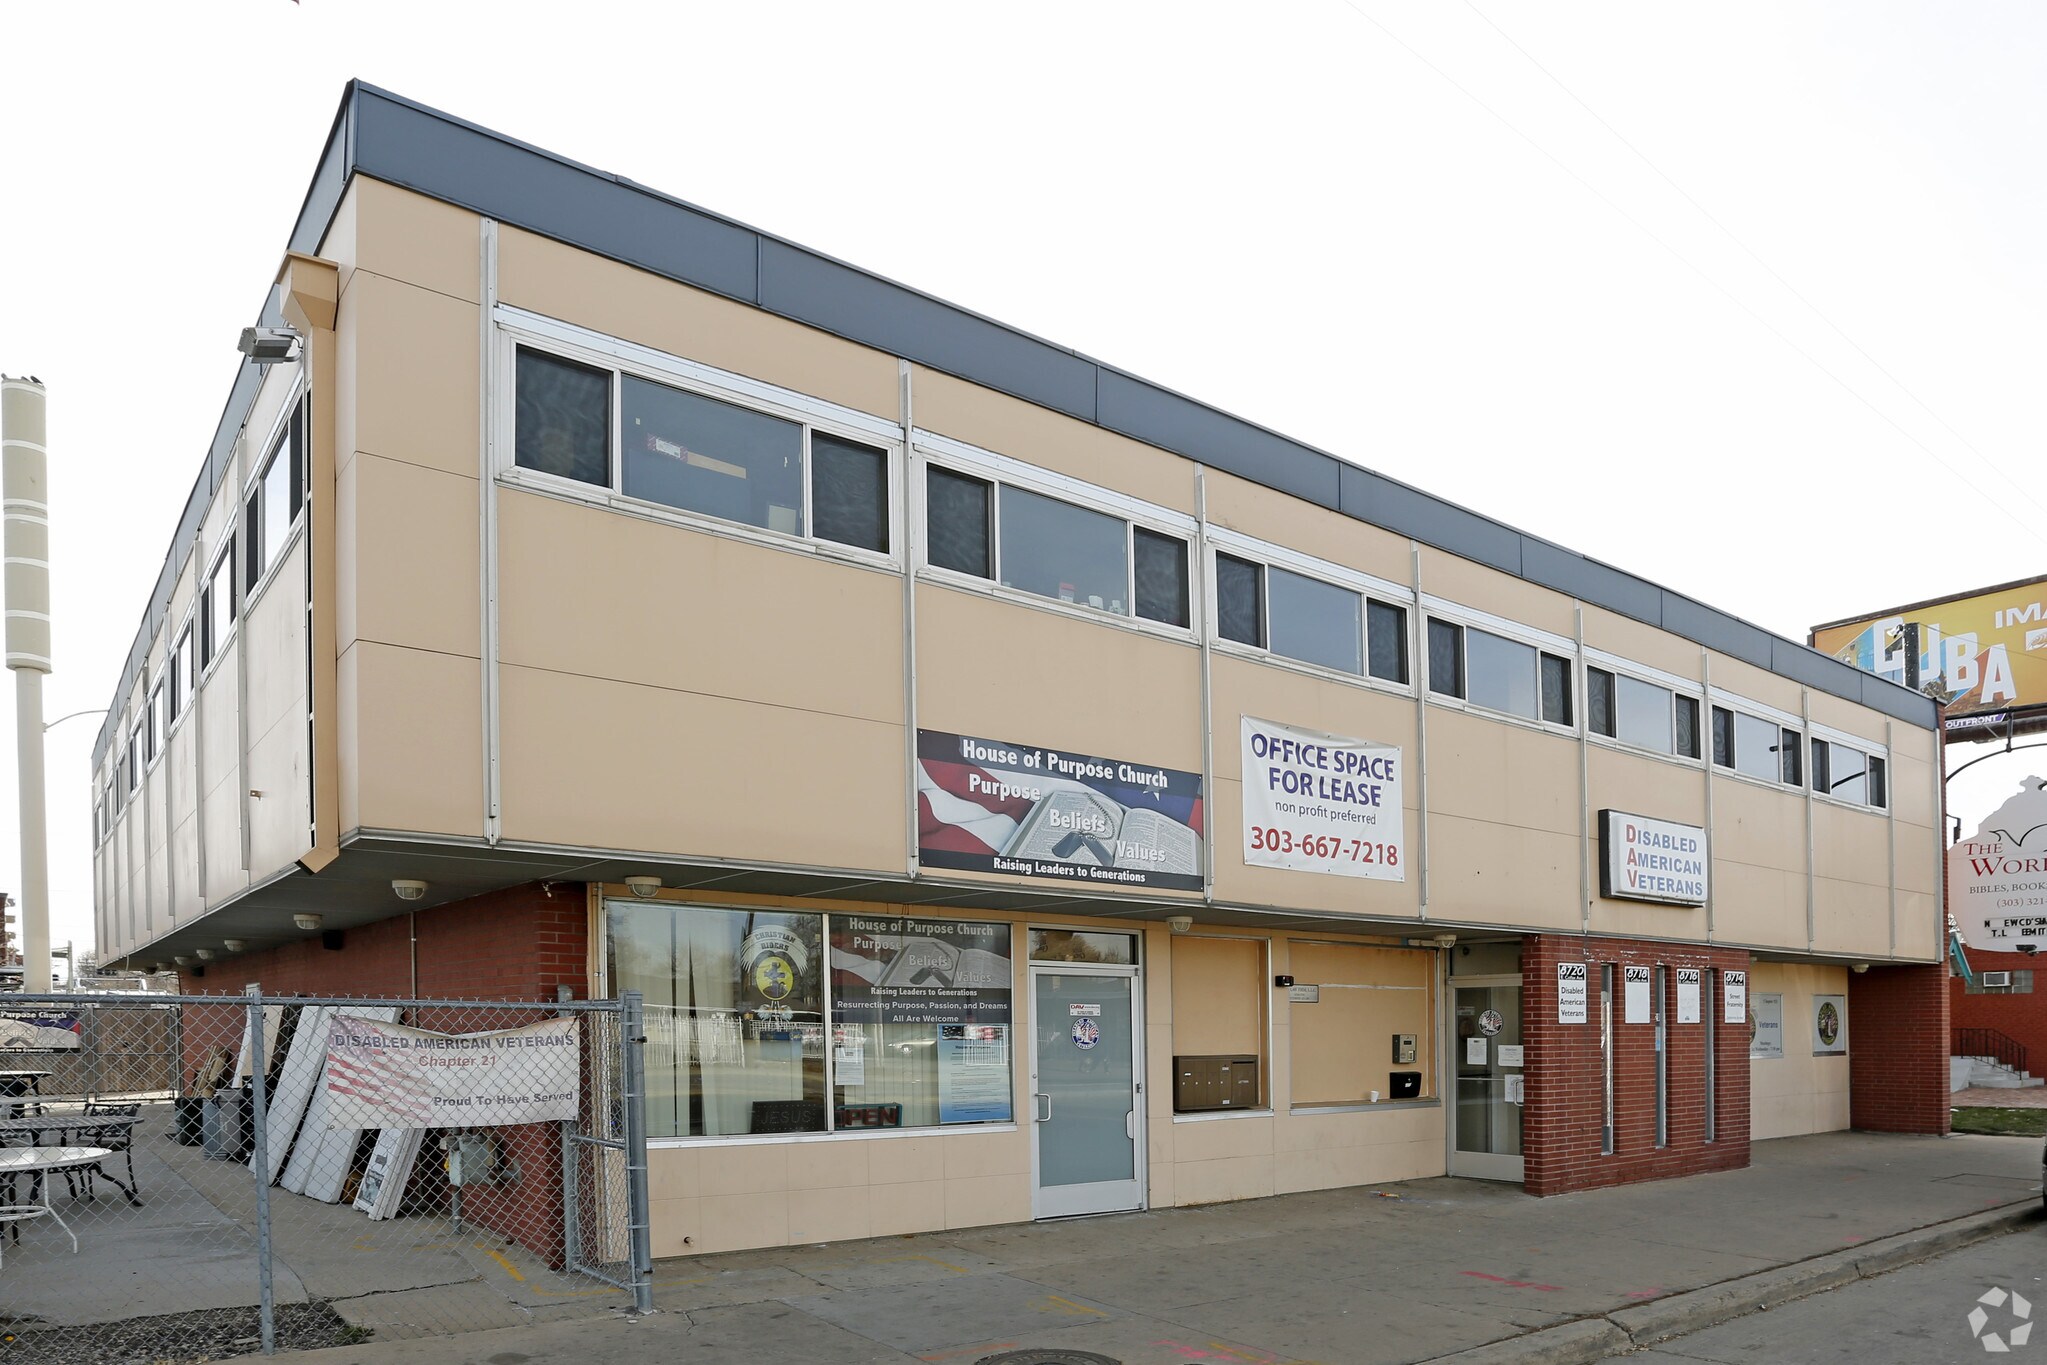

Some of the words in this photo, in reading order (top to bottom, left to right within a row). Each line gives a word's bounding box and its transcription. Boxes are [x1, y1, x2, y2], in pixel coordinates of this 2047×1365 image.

[1995, 602, 2047, 629] IM
[1874, 617, 2017, 704] CUBA
[1946, 716, 1997, 729] OUTFRONT
[963, 739, 1017, 765] House
[1023, 751, 1041, 768] of
[1047, 753, 1113, 780] Purpose
[1118, 765, 1168, 788] Church
[1251, 733, 1328, 770] OFFICE
[1334, 750, 1395, 782] SPACE
[969, 773, 1041, 801] Purpose
[1269, 767, 1313, 797] FOR
[1319, 776, 1381, 807] LEASE
[1050, 808, 1106, 832] Beliefs
[1275, 801, 1295, 814] non
[1299, 805, 1328, 818] profit
[1331, 809, 1376, 825] preferred
[1251, 826, 1398, 866] 303-667-7218
[1626, 824, 1697, 853] DISABLED
[1116, 840, 1166, 862] Values
[1964, 843, 2003, 855] THE
[1627, 848, 1702, 875] AMERICAN
[993, 858, 1032, 874] Raising
[1035, 861, 1074, 876] Leaders
[1077, 866, 1088, 877] to
[1090, 867, 1146, 882] Generations
[1627, 869, 1703, 896] VETERANS
[1969, 884, 2009, 895] BIBLES,
[2012, 882, 2047, 892] BOOK
[1997, 898, 2024, 909] (303)
[849, 918, 887, 931] House
[891, 920, 903, 931] of
[907, 921, 954, 935] Purpose
[957, 923, 993, 936] Church
[755, 931, 795, 943] CHRISTIAN
[853, 937, 903, 952] Purpose
[761, 942, 789, 951] RIDERS
[909, 955, 949, 967] Beliefs
[955, 971, 992, 983] Values
[1560, 966, 1584, 976] 8720
[1627, 969, 1647, 978] 8718
[1680, 971, 1697, 981] 8716
[871, 988, 897, 996] Raising
[899, 988, 926, 996] Leaders
[837, 1001, 890, 1010] Resurrecting
[892, 1001, 928, 1010] Purpose,
[929, 1002, 961, 1010] Passion,
[979, 1002, 1007, 1010] Dreams
[1560, 998, 1585, 1006] American
[922, 1015, 959, 1023] Welcome
[336, 1034, 409, 1049] DISABLED
[414, 1037, 491, 1050] AMERICAN
[495, 1034, 574, 1048] VETERANS
[419, 1056, 477, 1067] Chapter
[481, 1055, 496, 1066] 21
[434, 1096, 472, 1106] Proud
[476, 1096, 493, 1105] To
[497, 1094, 529, 1105] Have
[533, 1091, 573, 1102] Served
[761, 1110, 811, 1125] JESUS
